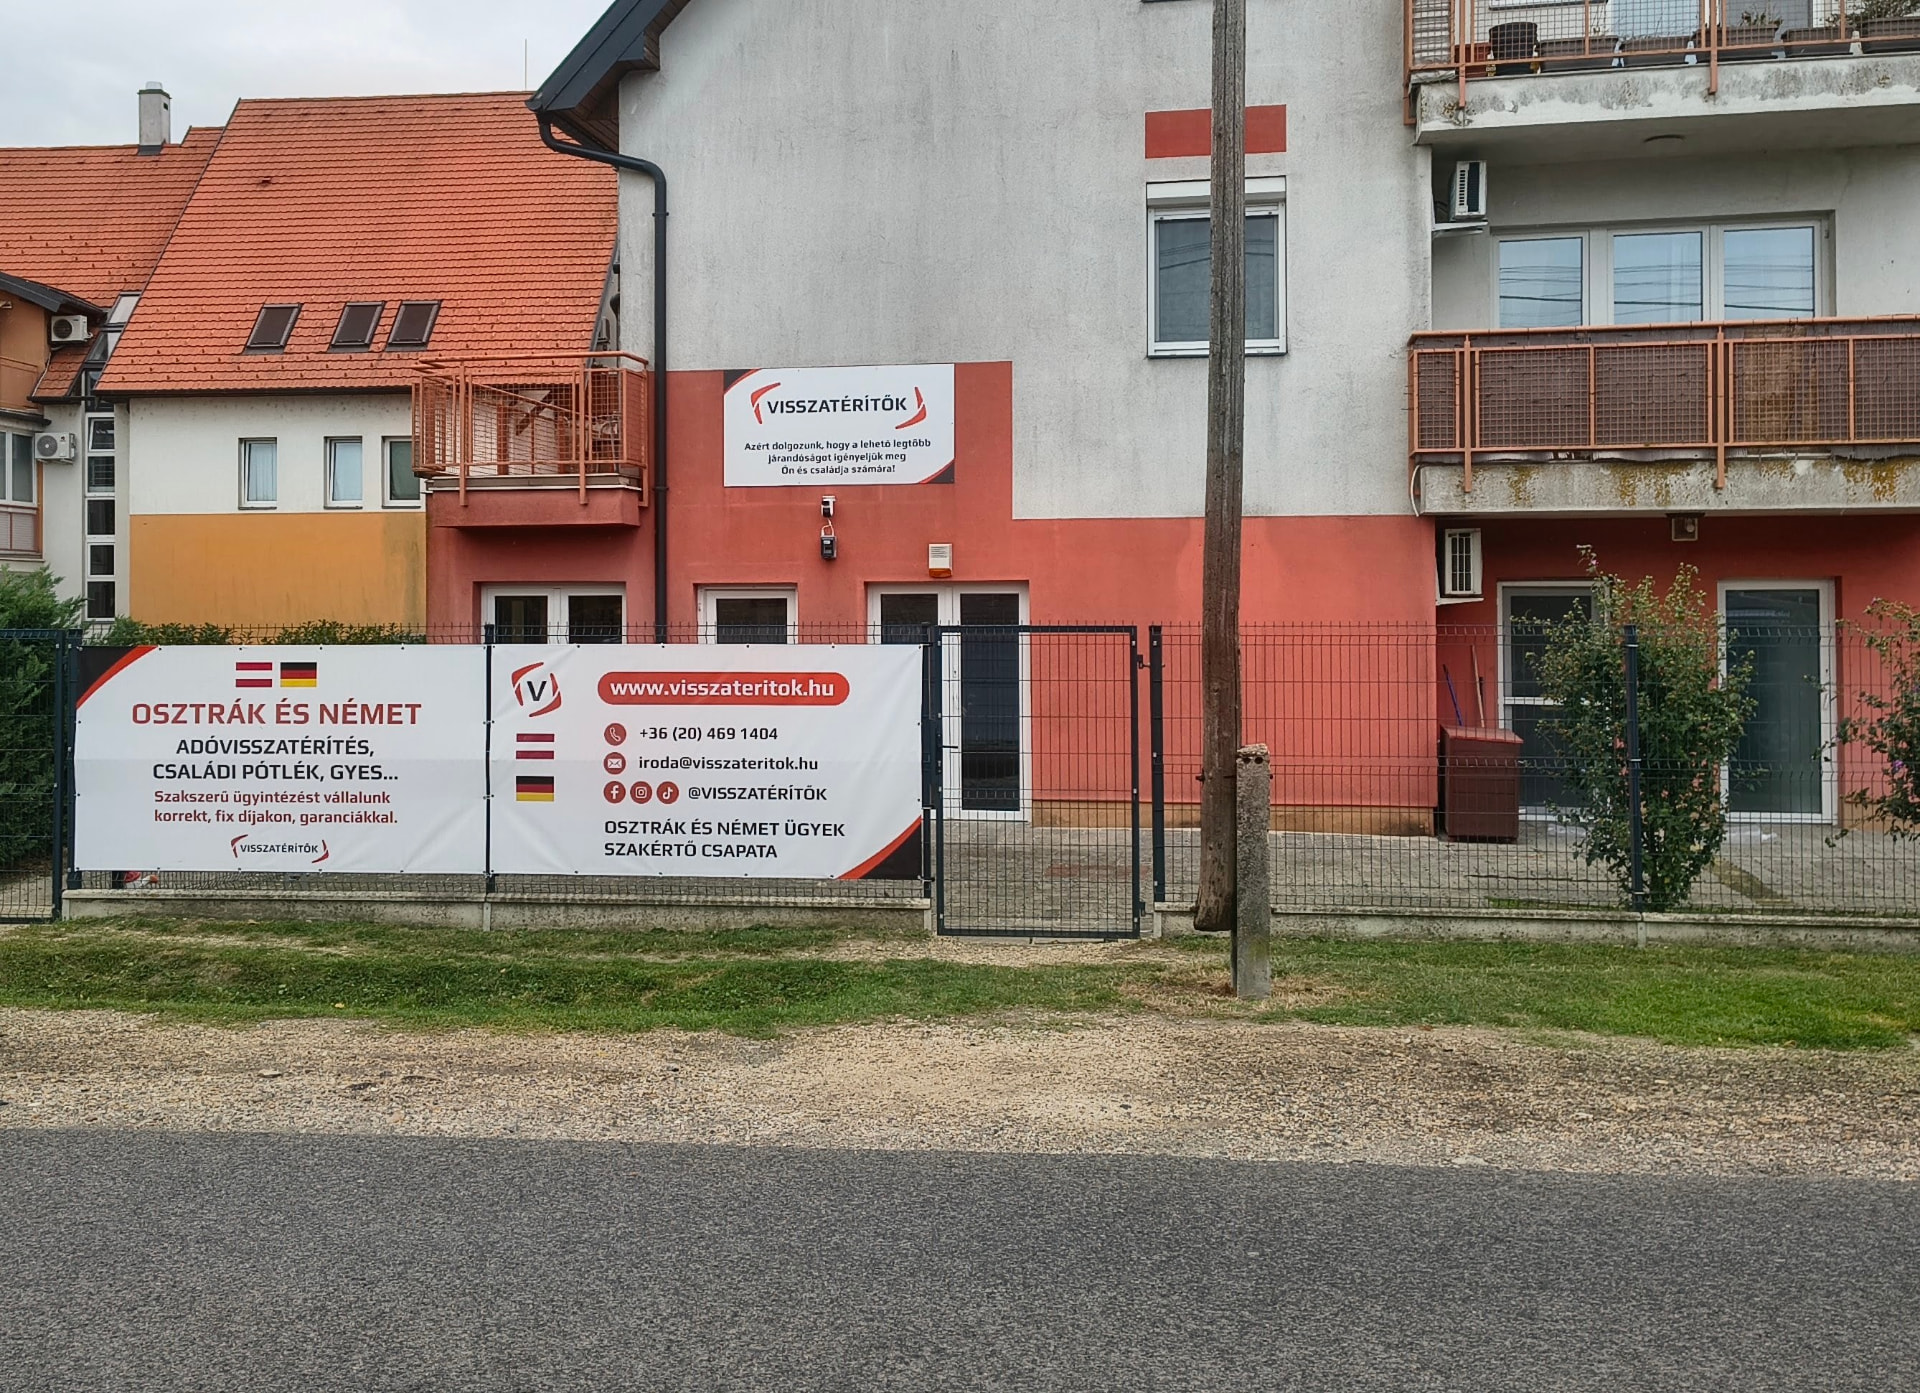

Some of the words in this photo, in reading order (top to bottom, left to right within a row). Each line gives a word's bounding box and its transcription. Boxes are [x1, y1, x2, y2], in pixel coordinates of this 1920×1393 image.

[767, 394, 908, 414] VISSZATÉRÍTŐK
[744, 442, 770, 451] Azért
[772, 440, 824, 452] dolgozunk,
[826, 440, 850, 451] hogy
[860, 440, 891, 449] lehető
[893, 439, 931, 450] legtöbb
[834, 452, 883, 463] igényeljük
[885, 454, 906, 464] meg
[781, 465, 795, 475] Ön
[797, 466, 808, 474] és
[810, 465, 849, 475] családja
[851, 464, 896, 474] számára!
[526, 680, 548, 702] V
[609, 679, 835, 698] www.visszateritok.hu
[132, 697, 267, 725] OSZTRÁK
[275, 698, 309, 725] ÉS
[319, 698, 422, 725] NÉMET
[639, 727, 668, 740] +36
[672, 726, 702, 742] (20)
[706, 727, 736, 740] 469
[740, 727, 778, 740] 1404
[176, 736, 375, 757] ADÓVISSZATÉRÍTÉS,
[638, 755, 819, 770] iroda@visszateritok.hu
[153, 761, 236, 780] CSALÁDI
[242, 761, 325, 782] PÓTLÉK,
[330, 764, 399, 780] GYES...
[154, 789, 229, 803] Szakszerű
[233, 790, 320, 806] ügyintézést
[324, 789, 390, 803] vállalunk
[688, 785, 828, 801] @VISSZATÉRÍTŐK
[154, 809, 212, 824] korrekt,
[215, 809, 235, 823] fix
[238, 809, 296, 826] díjakon,
[299, 809, 398, 826] garanciákkal.
[604, 818, 687, 835] OSZTRÁK
[691, 819, 713, 836] ÉS
[717, 819, 780, 836] NÉMET
[784, 819, 846, 837] ÜGYEK
[240, 841, 319, 855] VISSZATÉRÍTŐK
[604, 838, 697, 857] SZAKÉRTŐ
[701, 842, 778, 859] CSAPATA
